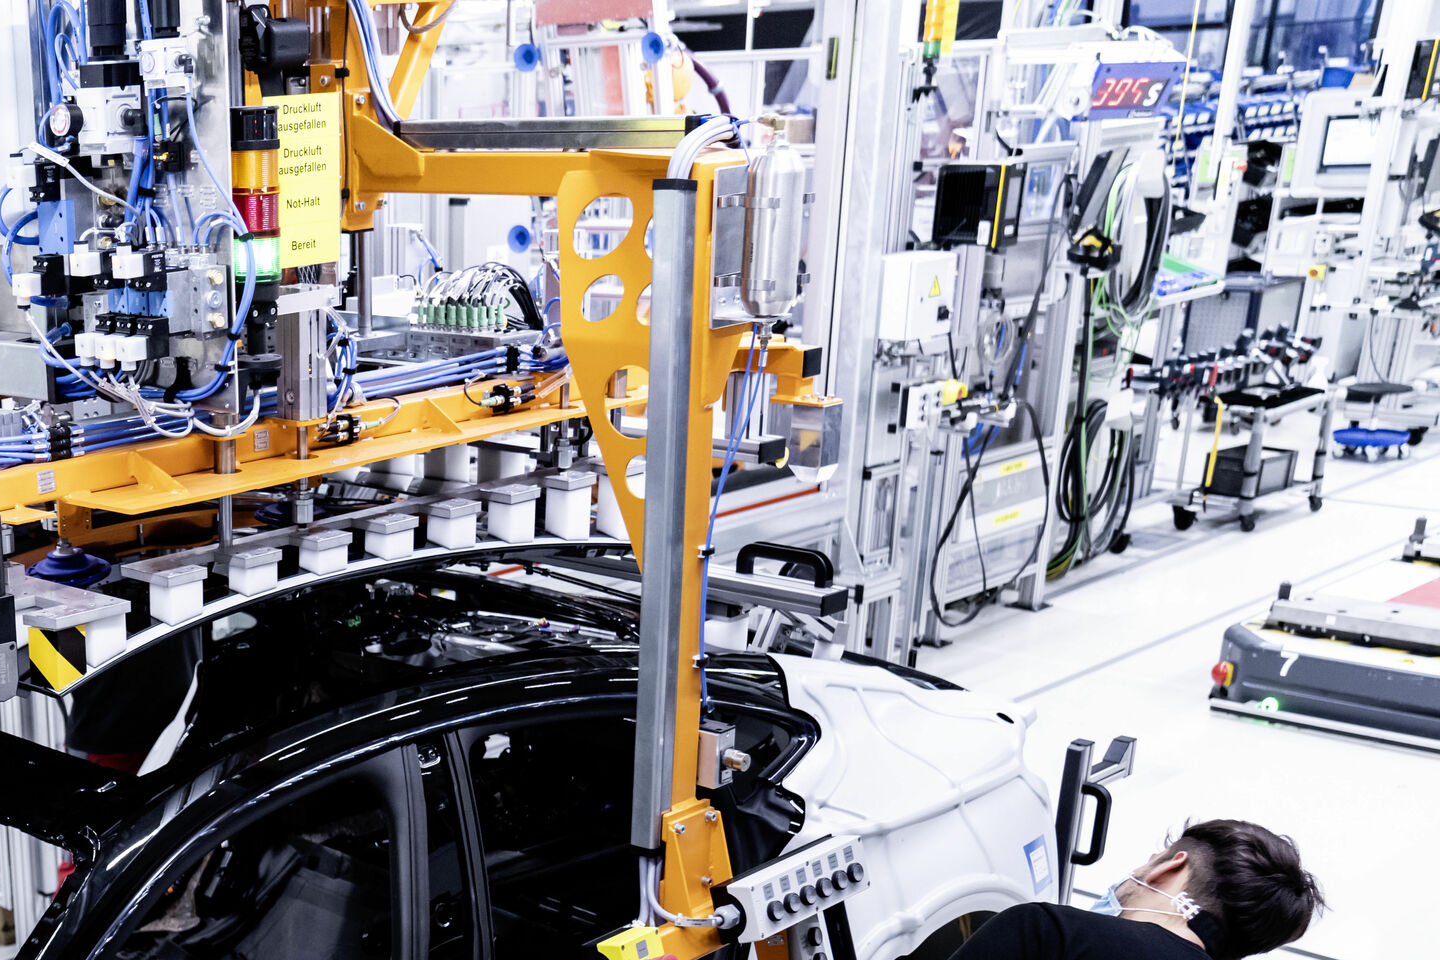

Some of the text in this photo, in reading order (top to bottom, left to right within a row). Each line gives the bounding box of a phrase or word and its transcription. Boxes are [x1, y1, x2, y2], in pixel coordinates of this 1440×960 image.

[282, 102, 321, 114] Druckluft
[278, 120, 327, 133] ausgefallen
[283, 145, 322, 158] Druckluft
[278, 162, 327, 176] ausgefallen
[286, 196, 320, 209] Not-Halt
[291, 239, 317, 251] Bereit
[1279, 650, 1300, 677] 7
